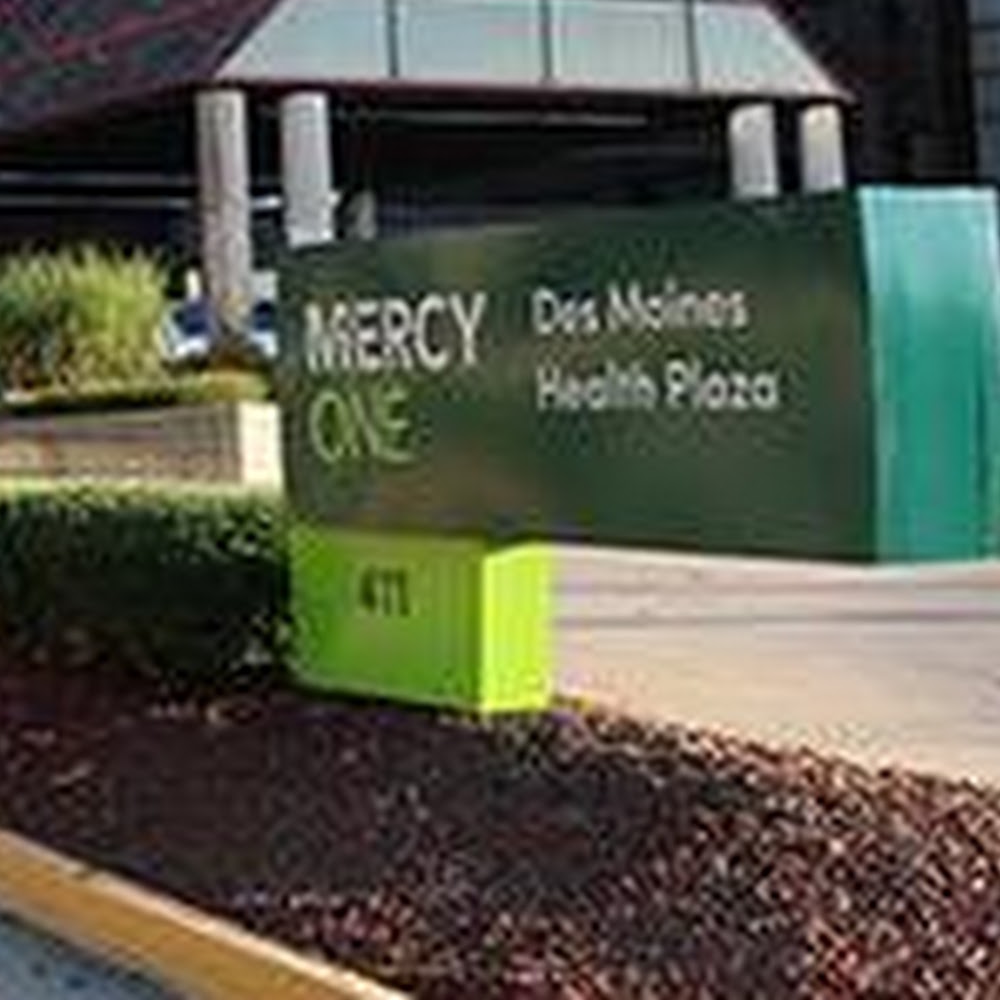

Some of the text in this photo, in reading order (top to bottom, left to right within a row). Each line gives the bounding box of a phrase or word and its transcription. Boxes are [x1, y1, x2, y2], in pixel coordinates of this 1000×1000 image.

[305, 293, 487, 374] MERCY
[531, 278, 749, 334] Des Moines
[535, 360, 780, 411] Health Plaza
[308, 386, 413, 463] ONE
